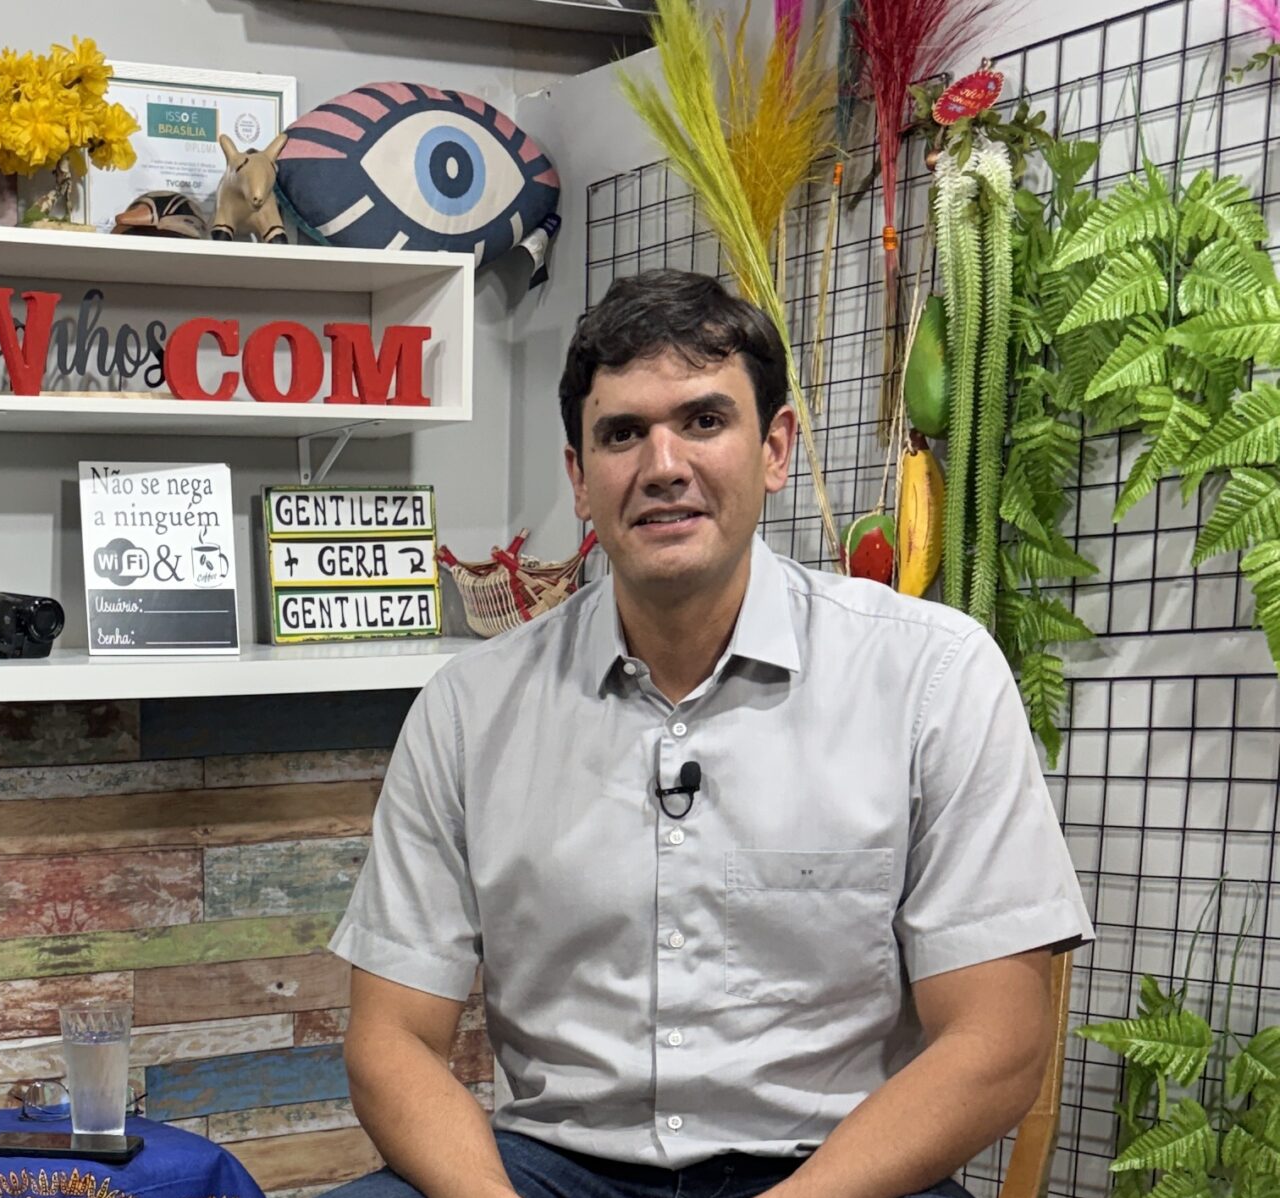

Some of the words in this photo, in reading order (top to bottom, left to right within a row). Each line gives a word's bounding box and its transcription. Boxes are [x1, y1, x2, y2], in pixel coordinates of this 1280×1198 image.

[158, 123, 206, 137] BRASÍLIA
[166, 111, 189, 123] ISSO
[191, 111, 199, 124] É
[91, 467, 133, 495] Não
[141, 478, 160, 495] se
[167, 477, 213, 505] nega
[94, 511, 106, 526] a
[114, 502, 220, 535] ninguém
[275, 495, 425, 526] GENTILEZA
[153, 544, 185, 582] &
[317, 544, 388, 578] GERA
[282, 595, 431, 628] GENTILEZA
[97, 628, 135, 645] Senha:
